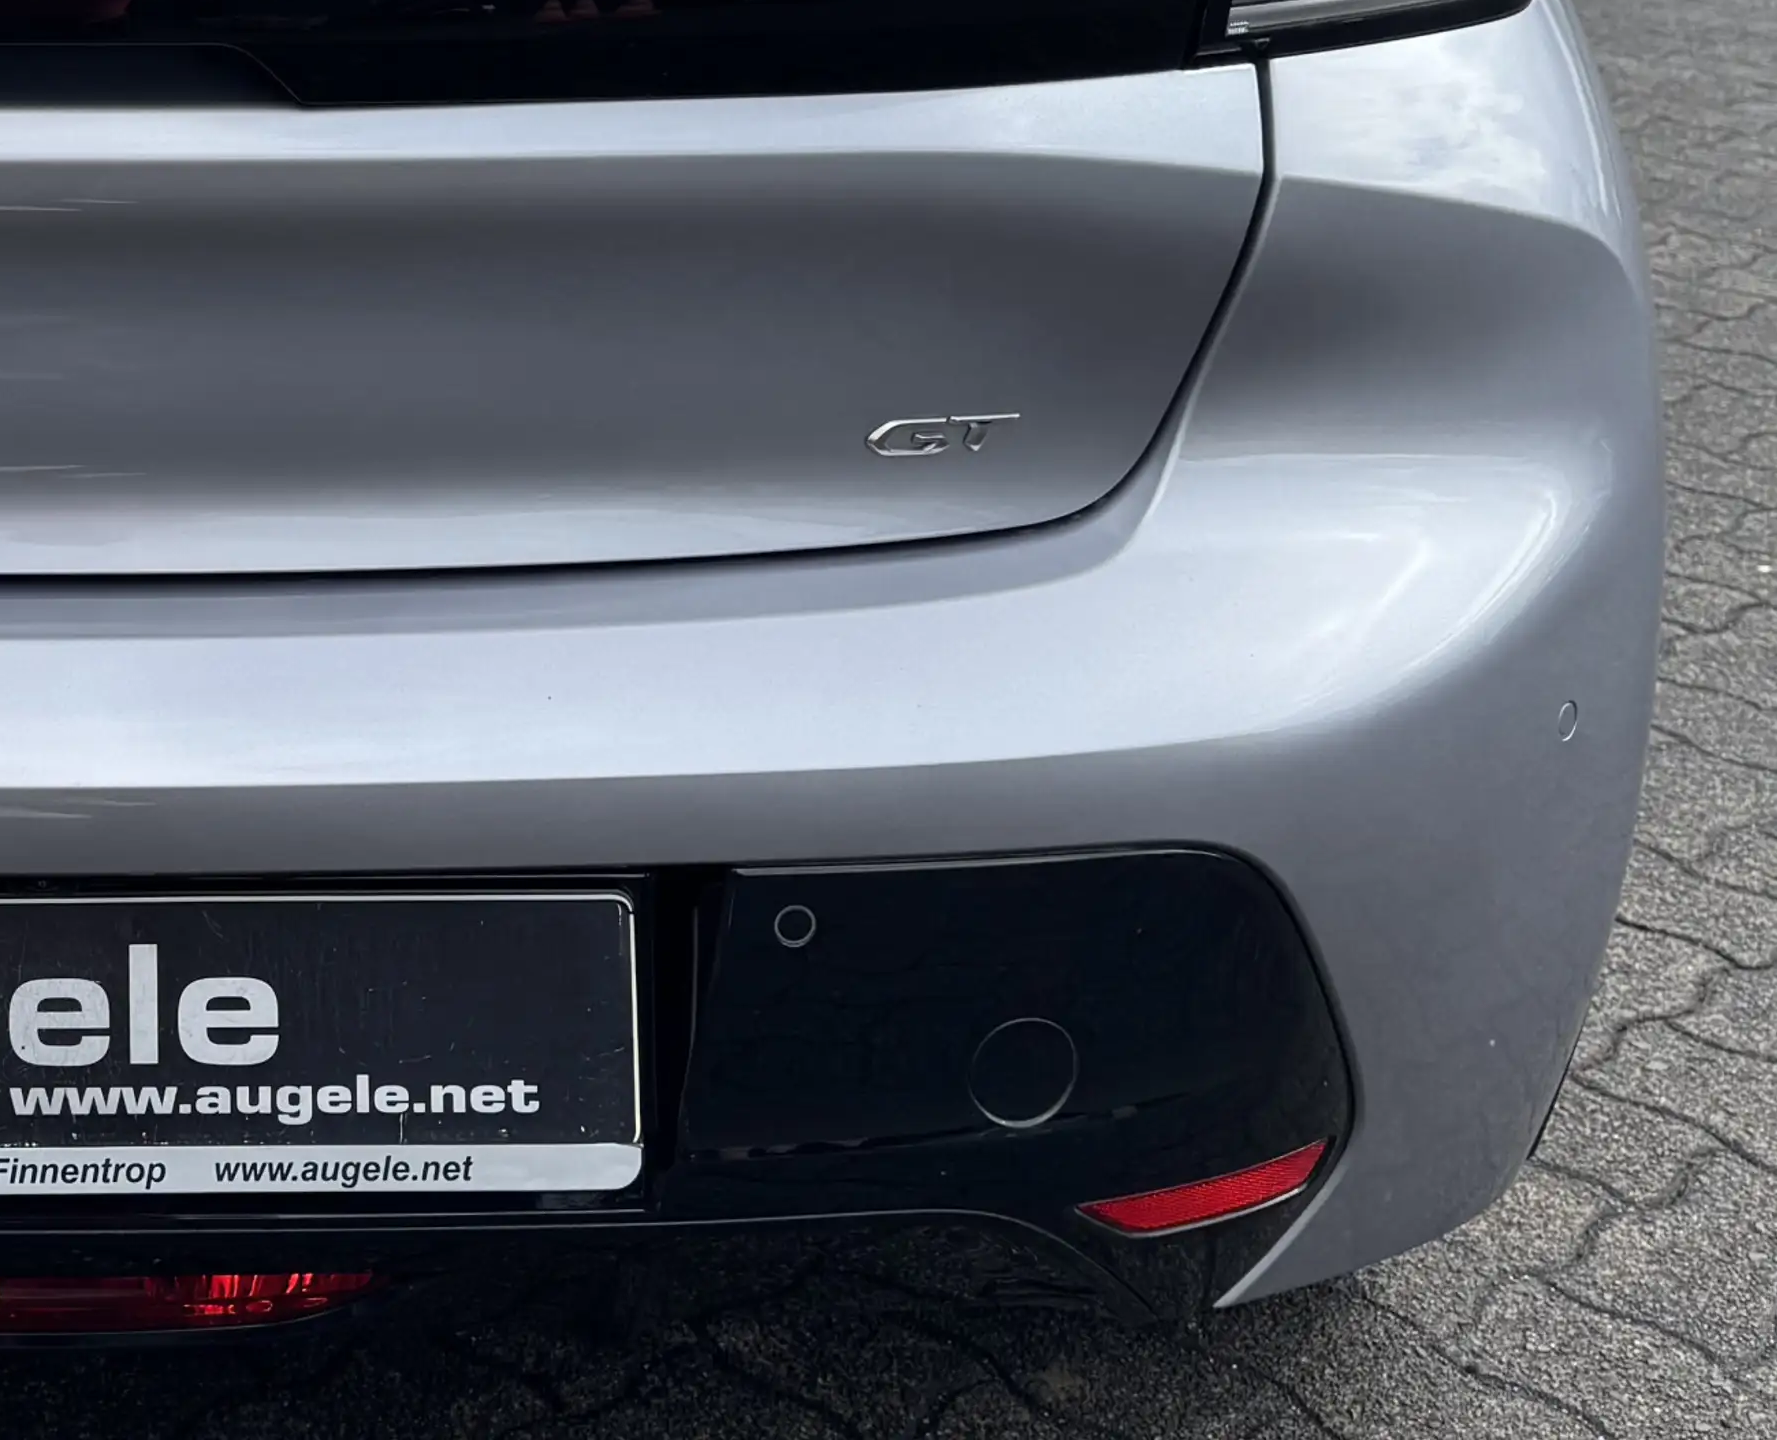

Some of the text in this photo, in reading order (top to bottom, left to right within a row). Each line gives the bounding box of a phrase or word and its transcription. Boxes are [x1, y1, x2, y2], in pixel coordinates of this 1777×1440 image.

[865, 412, 1021, 457] GT
[9, 1074, 541, 1126] www.augele.net
[213, 1155, 474, 1186] www.augele.net
